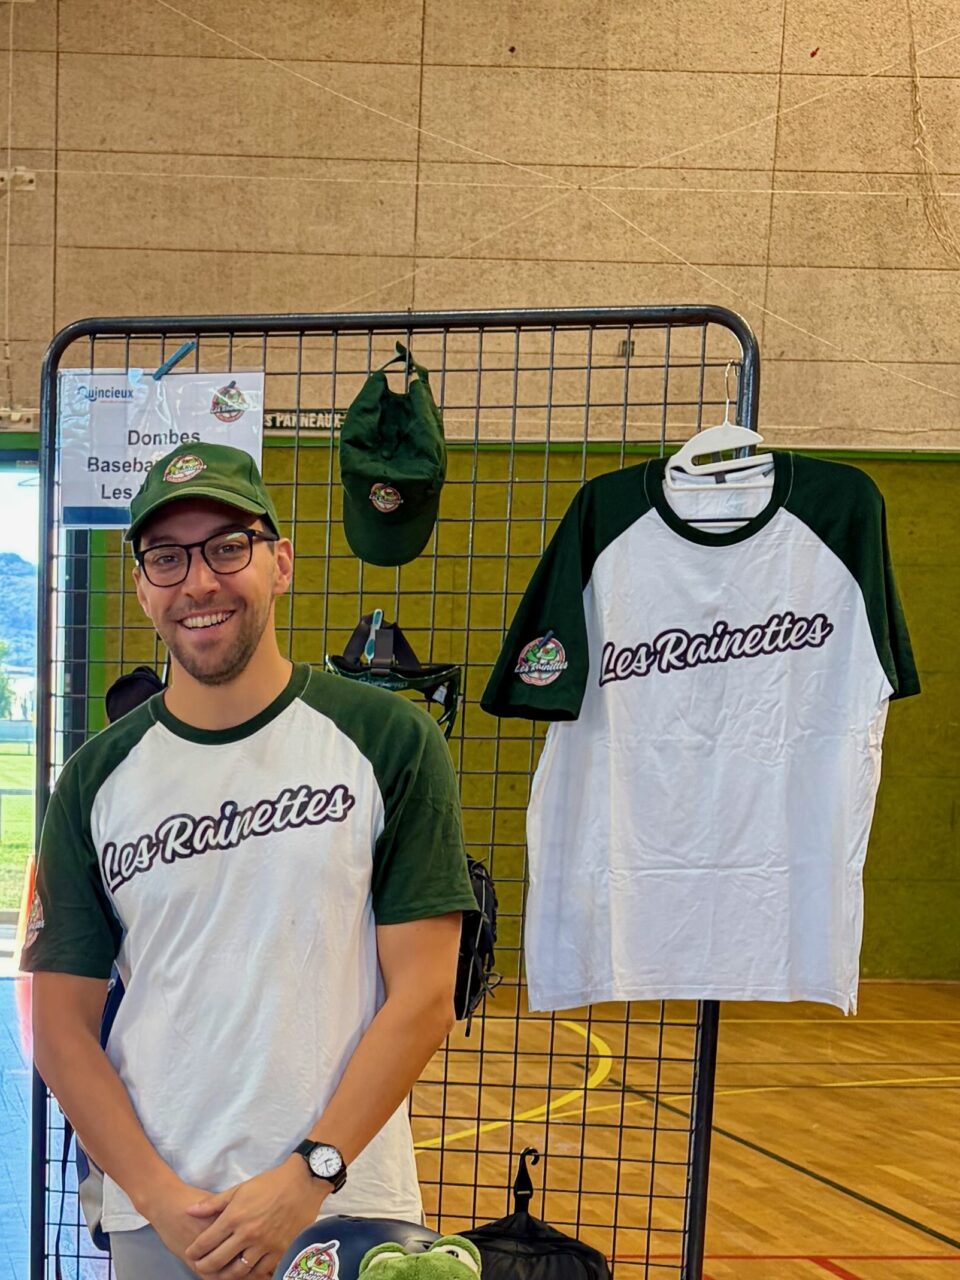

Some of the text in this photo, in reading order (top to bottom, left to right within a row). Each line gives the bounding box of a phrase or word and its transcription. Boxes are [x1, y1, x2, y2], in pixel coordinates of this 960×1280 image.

[77, 385, 134, 402] Quincieux
[128, 429, 200, 446] Dombes
[87, 456, 154, 473] Baseba
[101, 484, 133, 500] Les
[599, 611, 834, 687] Les Rainettes
[102, 784, 356, 894] Les Rainettes
